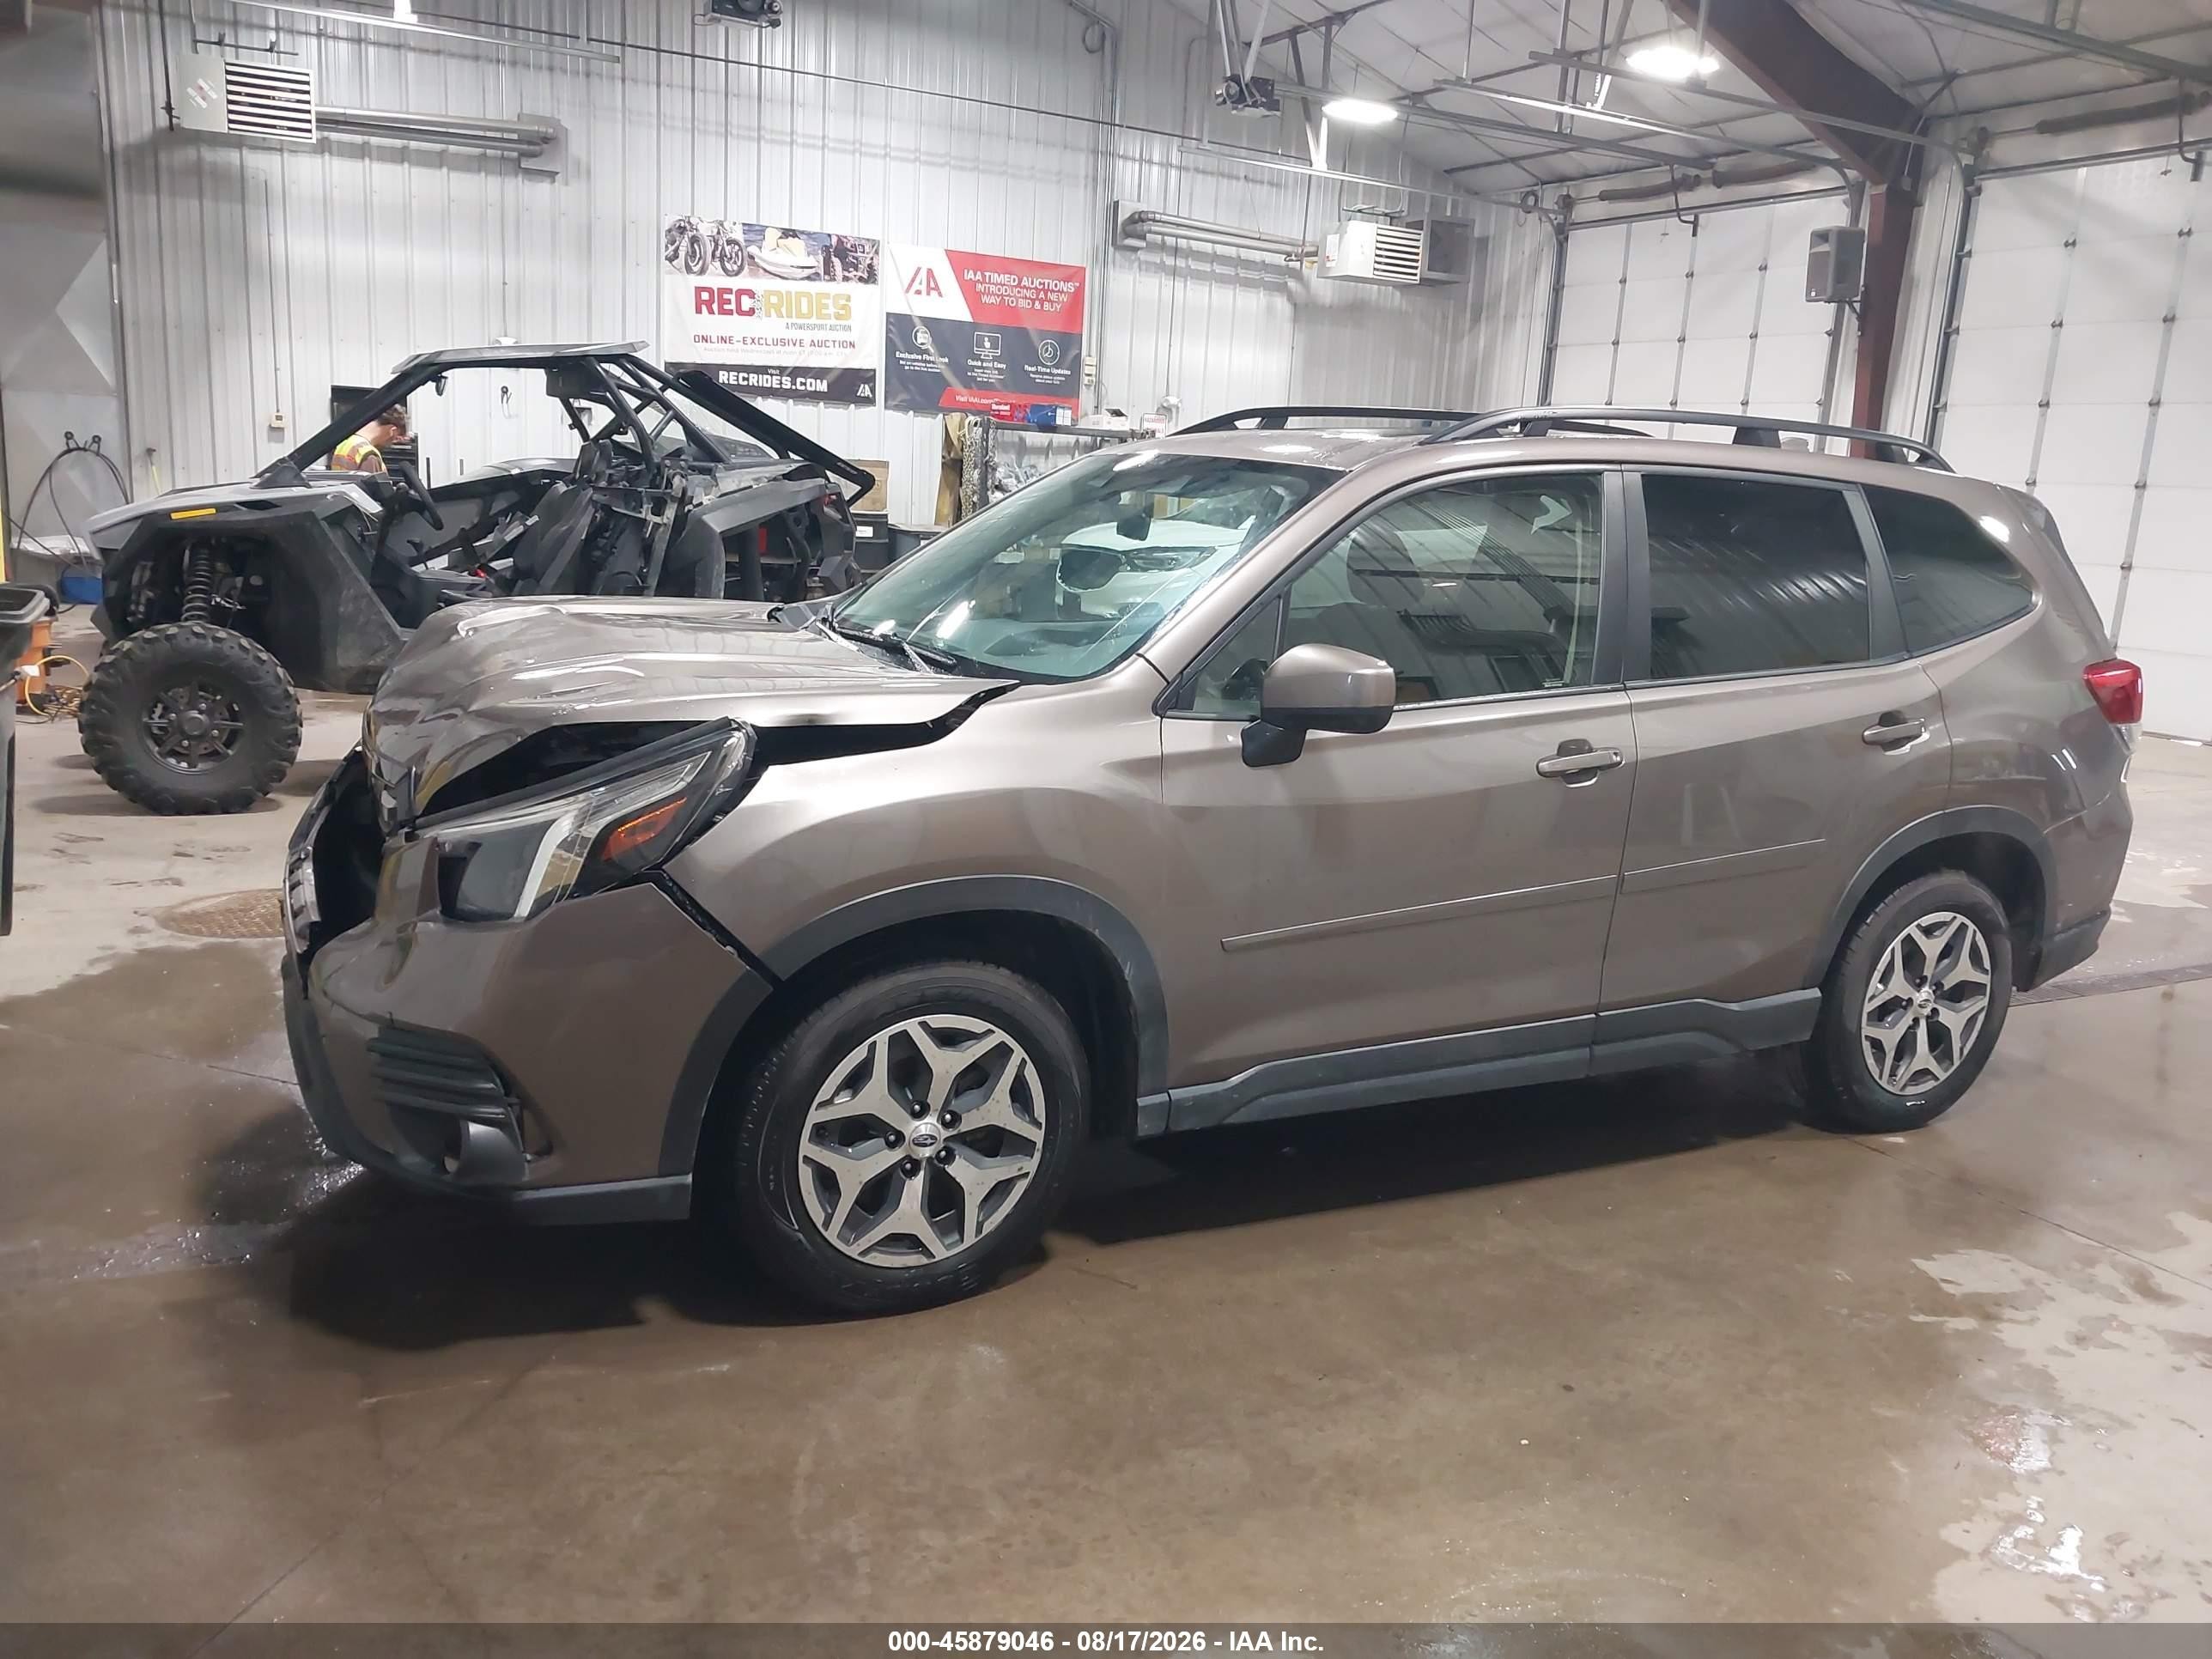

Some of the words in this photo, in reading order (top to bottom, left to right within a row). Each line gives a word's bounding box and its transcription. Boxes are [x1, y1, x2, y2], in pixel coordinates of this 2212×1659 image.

[963, 269, 983, 282] IAA
[983, 271, 1018, 286] TIMED
[975, 283, 1036, 299] INTRODUCING
[1038, 290, 1045, 299] A
[1047, 292, 1068, 302] NEW
[694, 286, 756, 317] REC
[763, 289, 852, 321] RIDES
[981, 294, 1001, 305] WAY
[1004, 295, 1017, 307] TO
[1018, 297, 1032, 309] BID
[1034, 300, 1042, 309] &
[1043, 301, 1062, 312] BUY
[790, 323, 828, 331] POWERSPORT
[829, 324, 852, 332] AUCTION
[693, 334, 805, 348] ONLINE-EXCLUSIVE
[809, 338, 856, 349] AUCTION
[994, 362, 1006, 370] Easy
[1024, 364, 1050, 374] Real-Time
[1050, 366, 1072, 375] Updates
[718, 370, 828, 392] RECRIDES.COM
